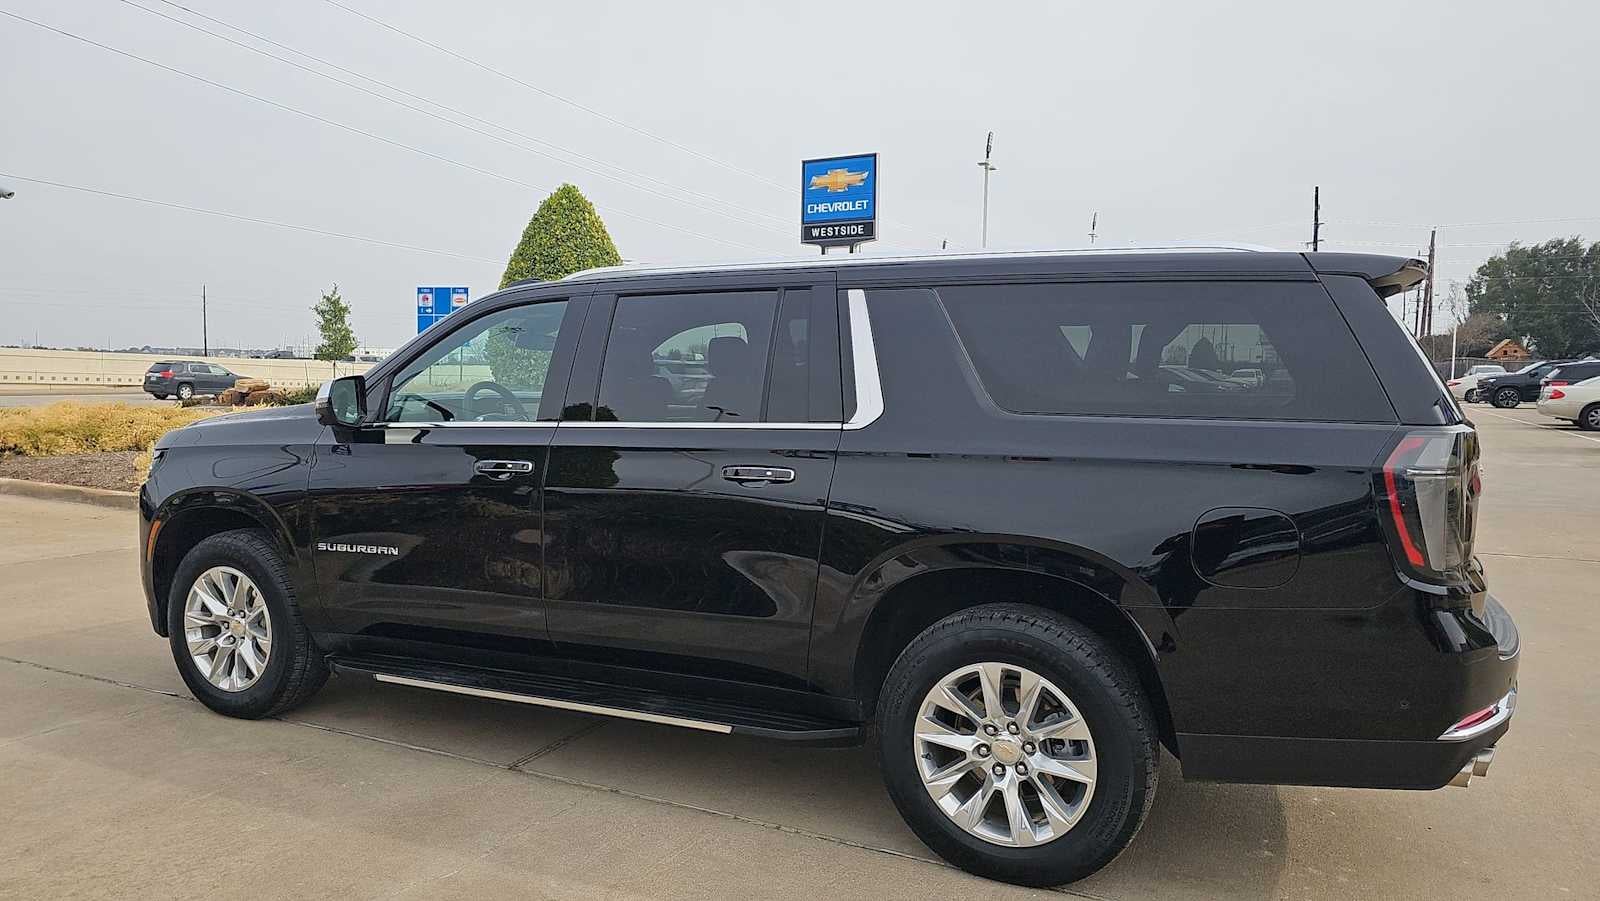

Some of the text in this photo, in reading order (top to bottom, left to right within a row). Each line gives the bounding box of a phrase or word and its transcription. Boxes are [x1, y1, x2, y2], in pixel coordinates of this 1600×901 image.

[808, 199, 869, 214] CHEVROLET
[812, 225, 864, 237] WESTSIDE
[317, 542, 399, 555] SUBURBAN
